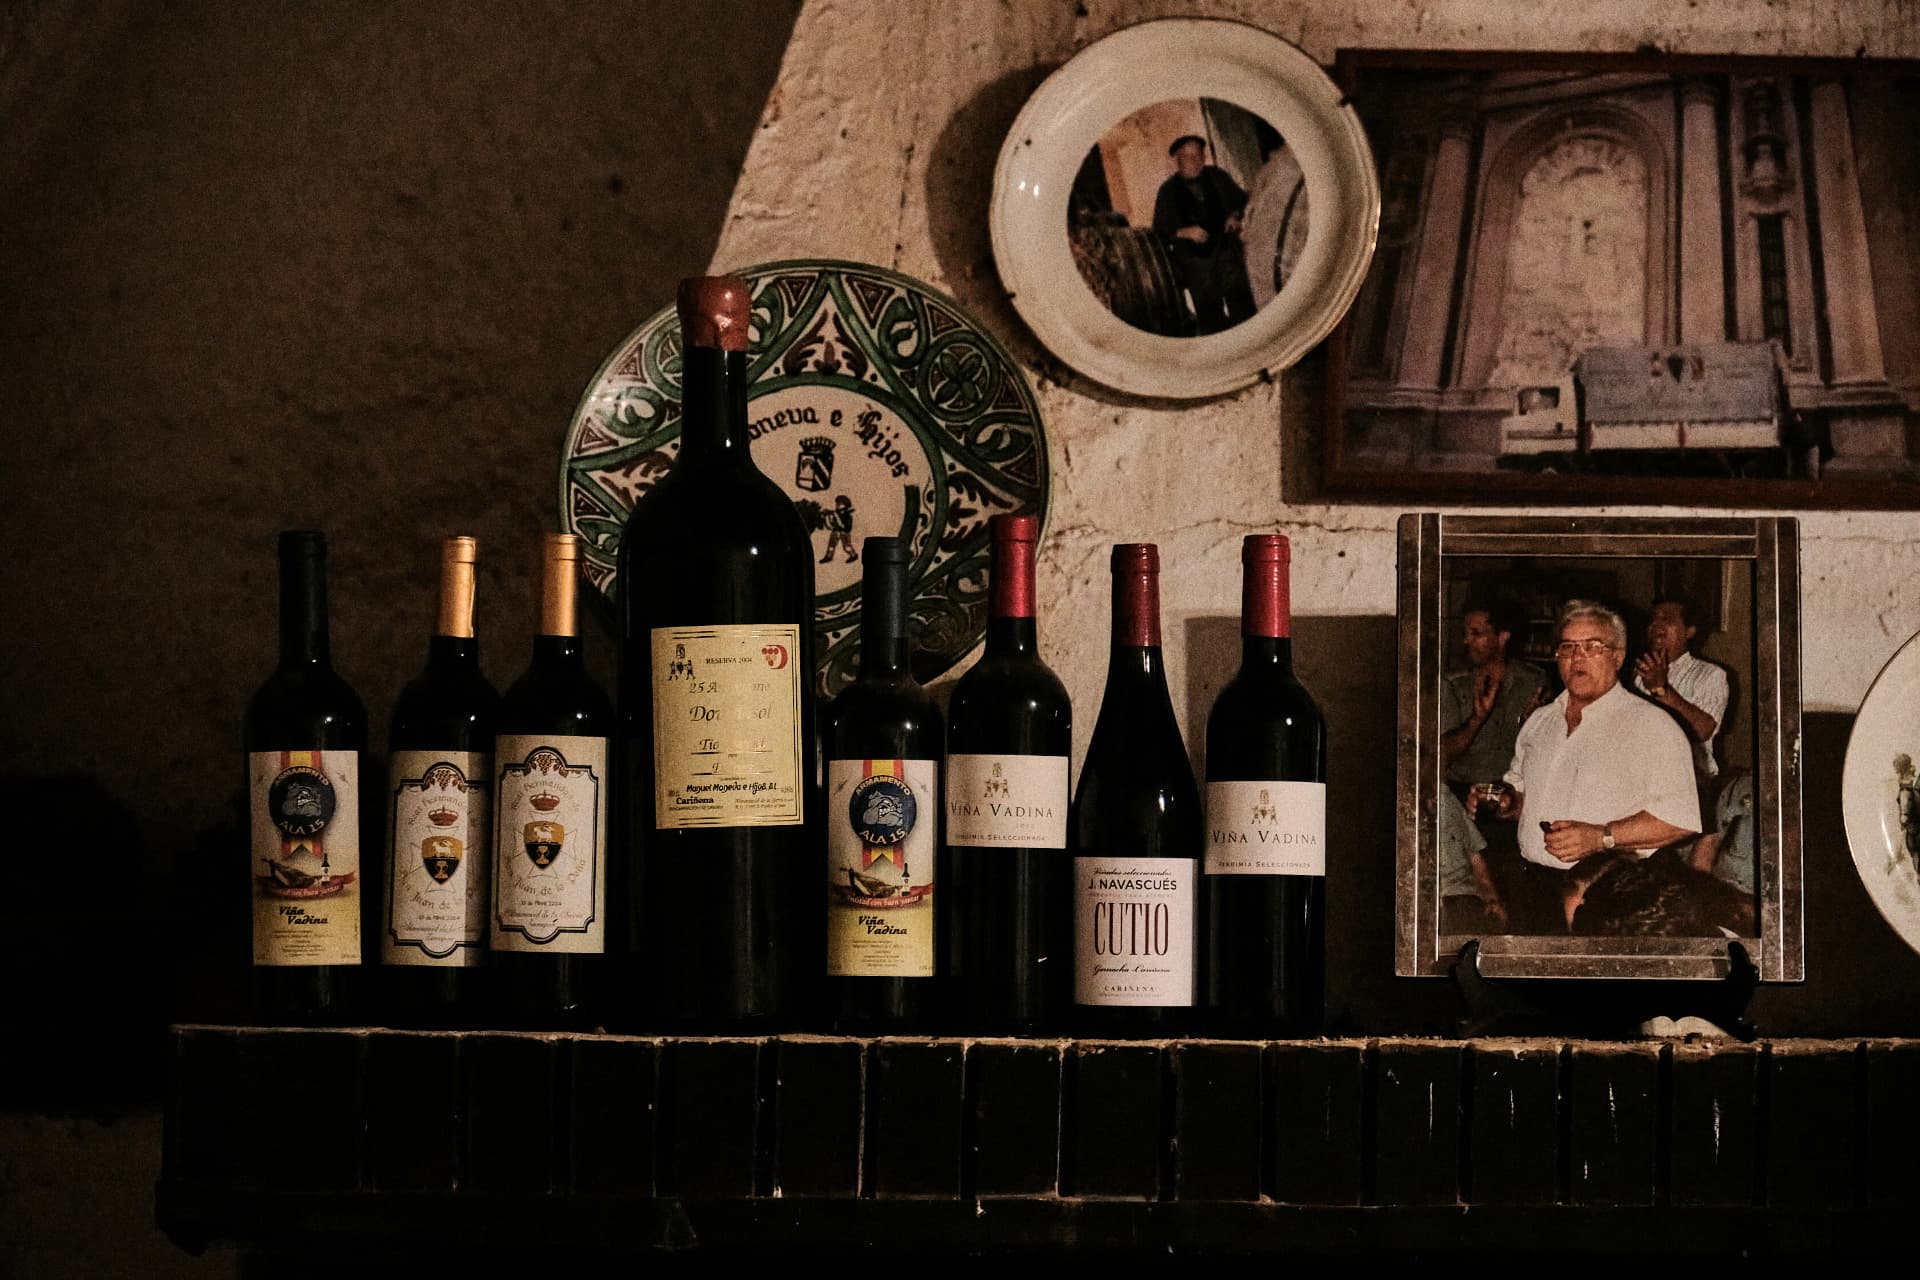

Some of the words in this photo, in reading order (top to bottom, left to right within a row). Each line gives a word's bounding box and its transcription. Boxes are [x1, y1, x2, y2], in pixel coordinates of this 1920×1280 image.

[747, 407, 820, 441] oneva
[830, 410, 843, 427] e
[855, 776, 912, 796] ARMAMENTO
[951, 802, 981, 817] VIÑA
[991, 803, 1053, 818] VADINA
[860, 830, 887, 845] ALA
[890, 828, 906, 842] 15
[1212, 830, 1249, 844] VIÑA
[1258, 830, 1317, 845] VADINA
[1088, 879, 1097, 890] J.
[1099, 877, 1177, 890] NAVASCUÉS
[280, 906, 305, 916] Viña
[288, 915, 328, 925] Vadina
[859, 915, 884, 926] Viña
[867, 925, 908, 935] Vadina
[1094, 901, 1169, 956] CUTIO
